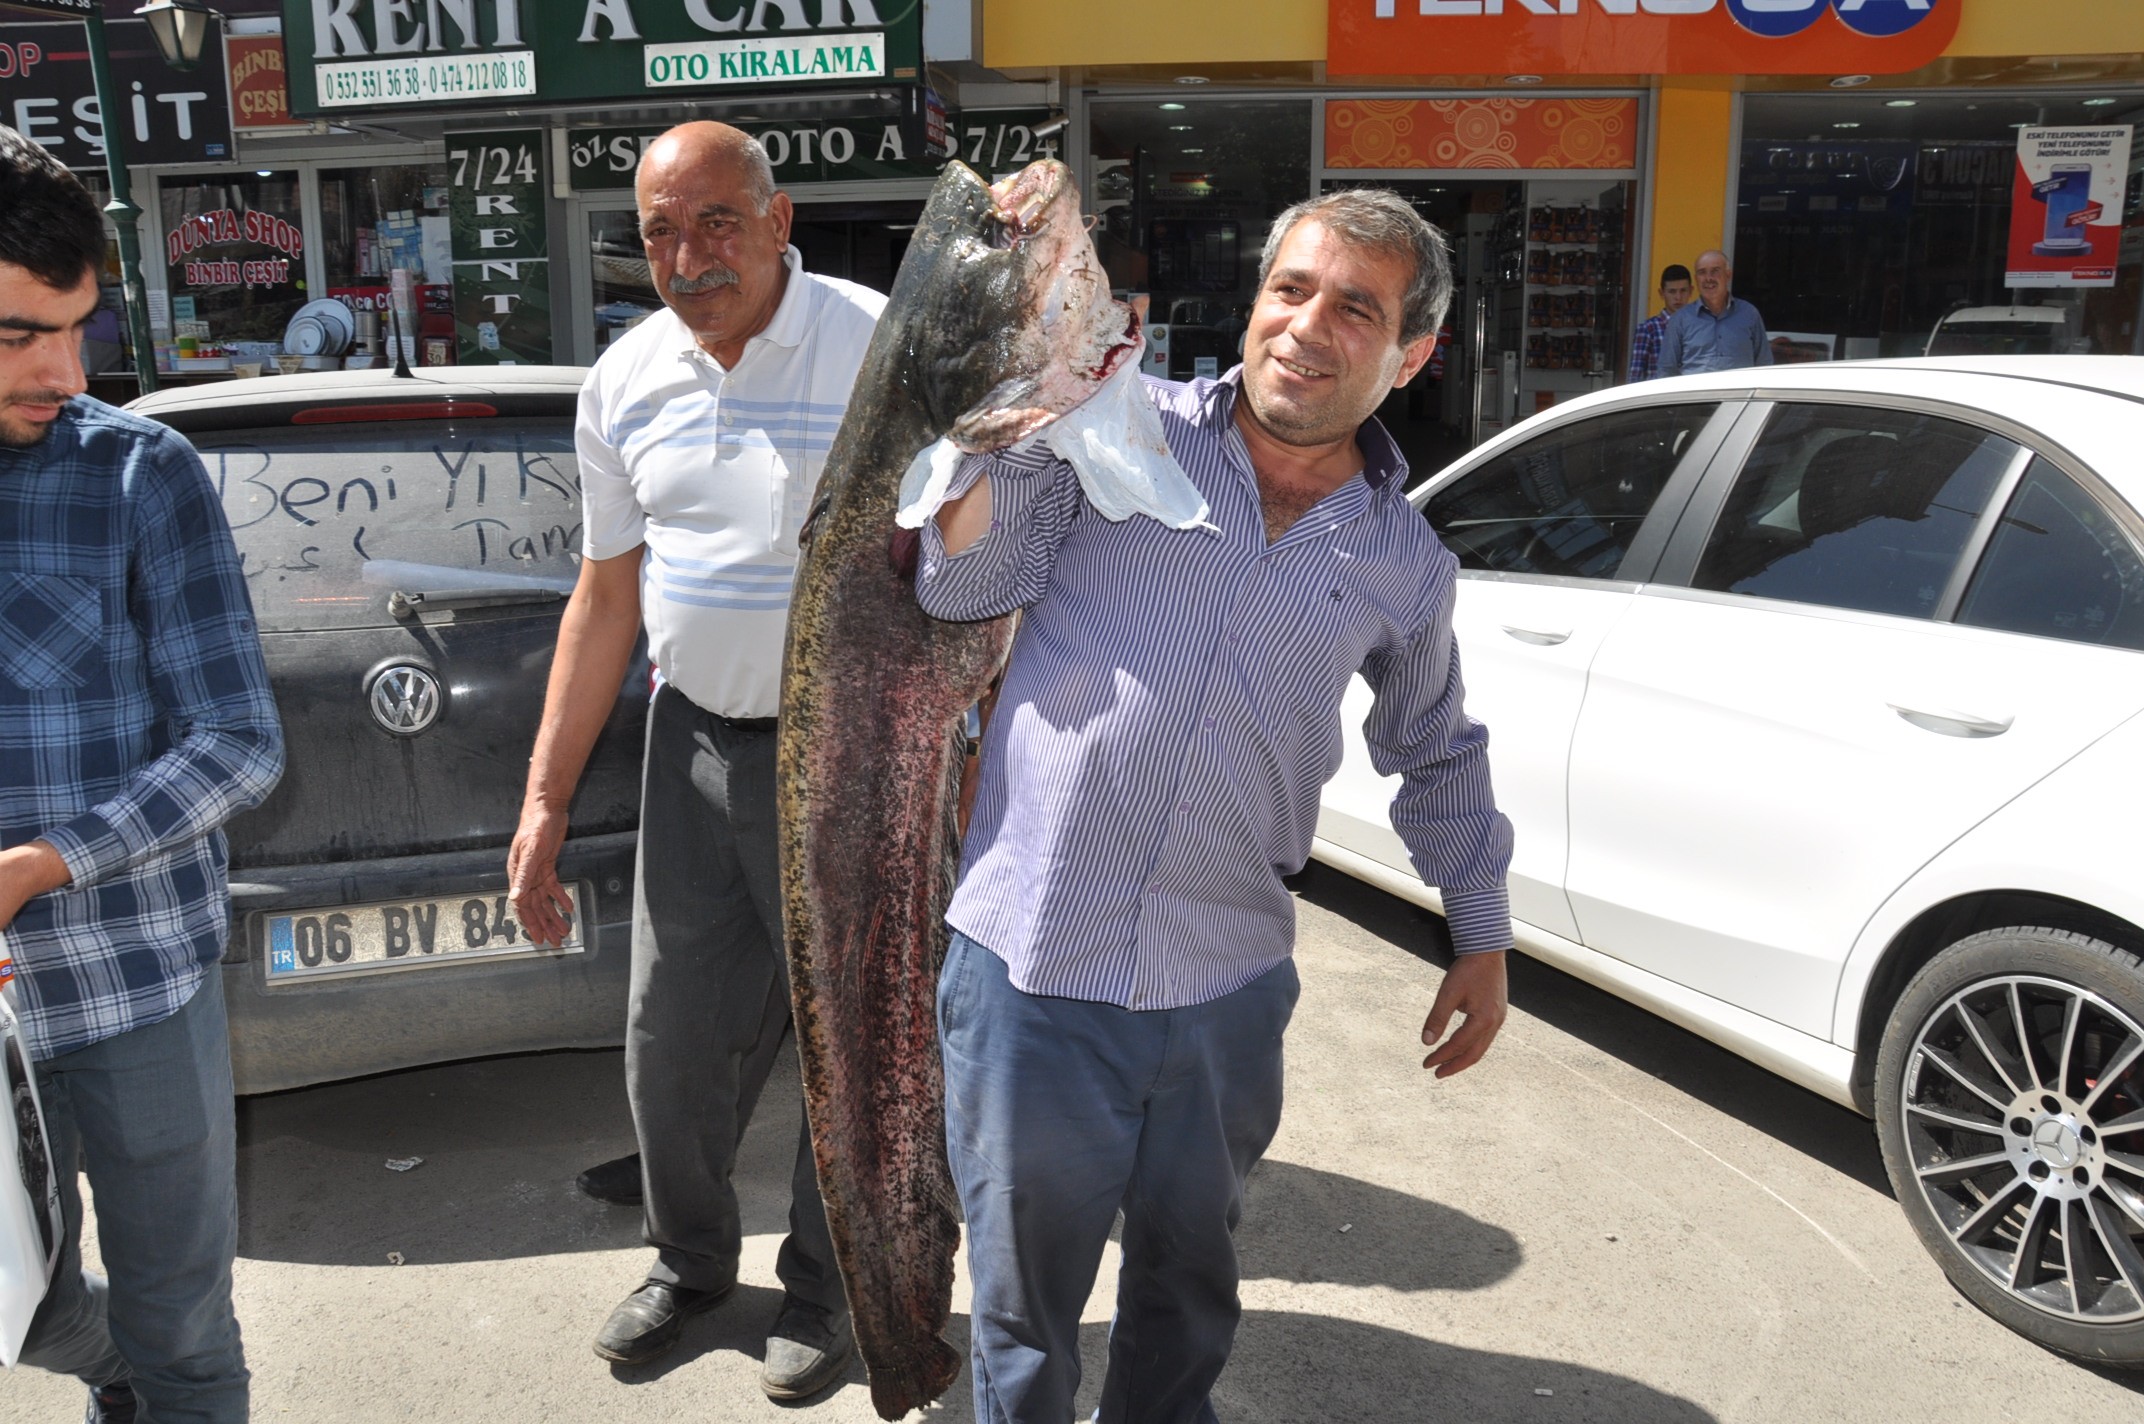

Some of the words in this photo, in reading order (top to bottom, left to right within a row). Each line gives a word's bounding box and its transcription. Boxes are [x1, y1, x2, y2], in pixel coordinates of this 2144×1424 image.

[233, 49, 285, 91] BİNB
[326, 73, 334, 99] 0
[337, 72, 358, 99] 532
[362, 71, 382, 97] 551
[387, 69, 401, 96] 36
[405, 67, 420, 95] 38
[430, 66, 437, 93] 0
[441, 63, 463, 92] 474
[467, 63, 488, 91] 212
[493, 61, 507, 89] 08
[512, 60, 526, 88] 18
[650, 53, 709, 82] OTO
[719, 43, 877, 79] KİRALAMA
[572, 135, 607, 168] ÖZ
[760, 125, 855, 168] OTO
[2026, 131, 2045, 139] ESKİ
[2046, 131, 2099, 139] TELEFONUNU
[2100, 130, 2125, 138] GETİR
[2036, 148, 2078, 157] İNDİRİMLE
[2038, 140, 2057, 148] YENİ
[2058, 140, 2112, 148] TELEFONUNU
[450, 144, 537, 191] 7/24
[167, 209, 241, 266] DÜNYA
[244, 209, 303, 260] SHOP
[475, 195, 522, 314] RENT
[185, 257, 242, 285] BİNBİR
[242, 255, 289, 290] ÇEŞİT
[203, 443, 397, 529] Beni
[295, 913, 353, 967] 06
[382, 903, 437, 958] BV
[462, 895, 572, 948] 84
[272, 951, 292, 965] TR
